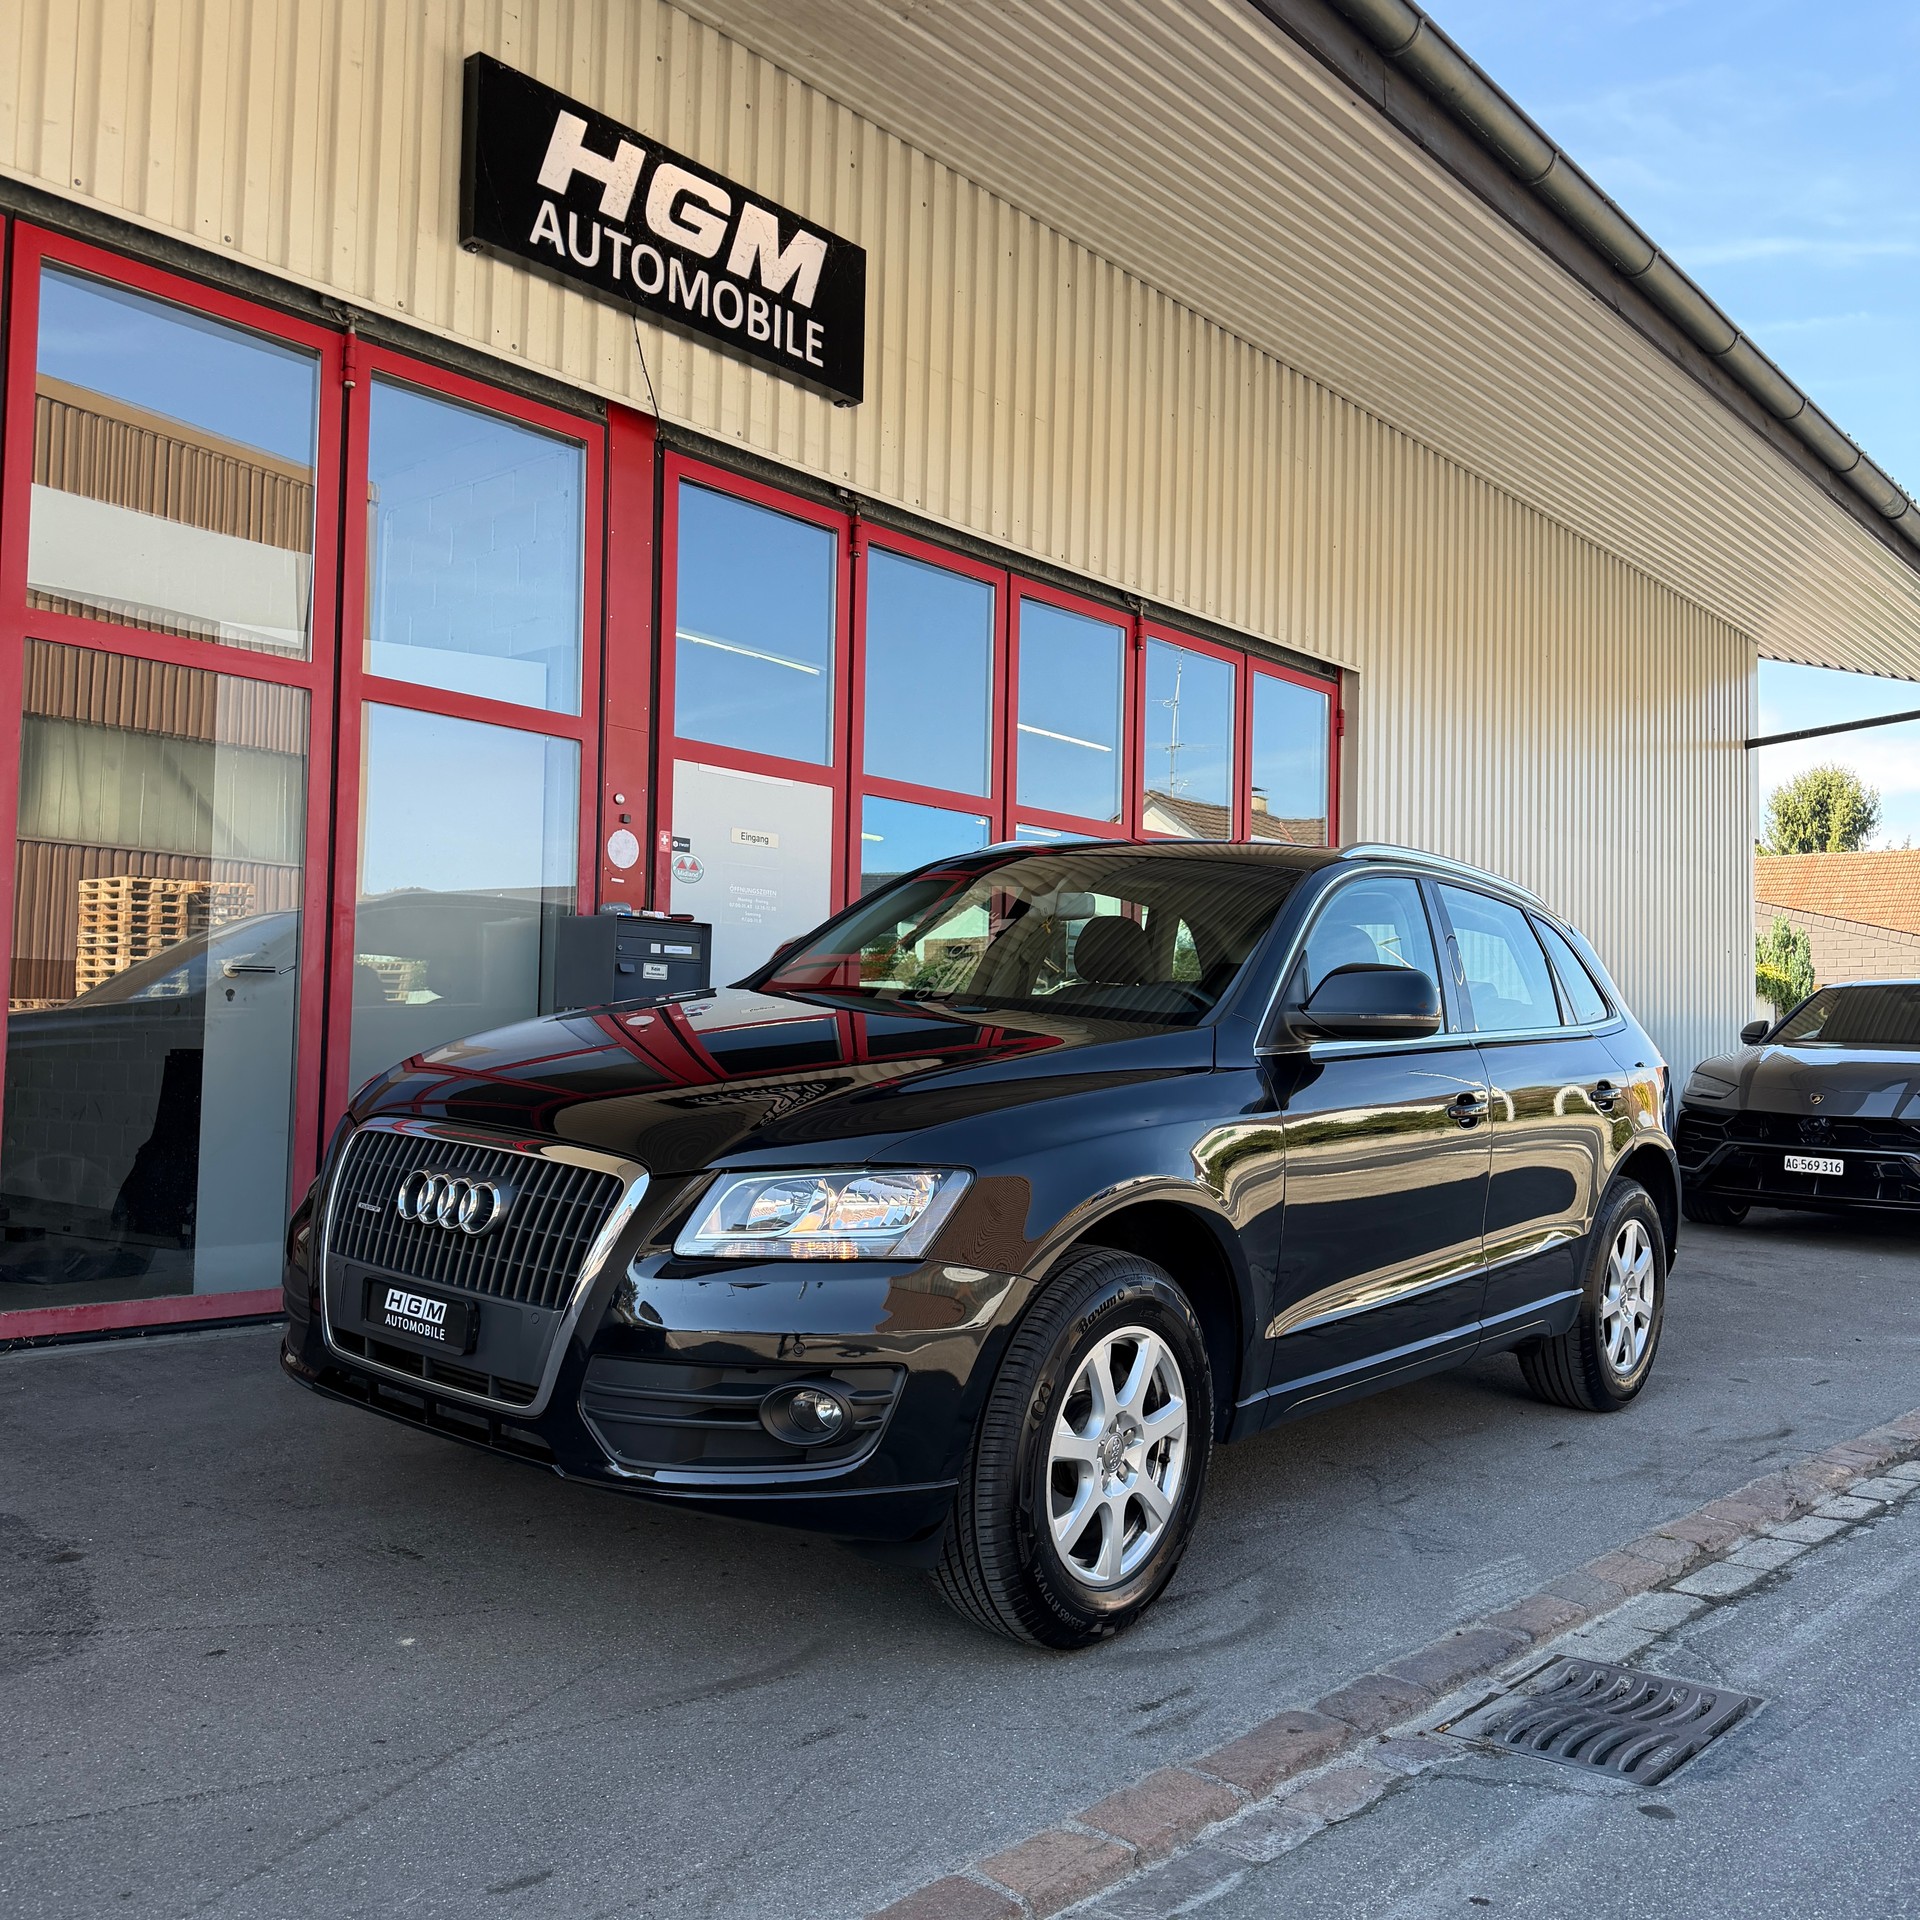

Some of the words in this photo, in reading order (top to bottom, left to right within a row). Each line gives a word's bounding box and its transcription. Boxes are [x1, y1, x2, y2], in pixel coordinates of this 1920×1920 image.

[537, 109, 828, 308] HGM
[529, 199, 825, 368] AUTOMOBILE
[740, 831, 769, 845] Eingang
[1822, 1161, 1842, 1173] 316
[387, 1290, 446, 1322] HGM
[1076, 1294, 1117, 1334] Barum
[384, 1313, 446, 1341] AUTOMOBILE
